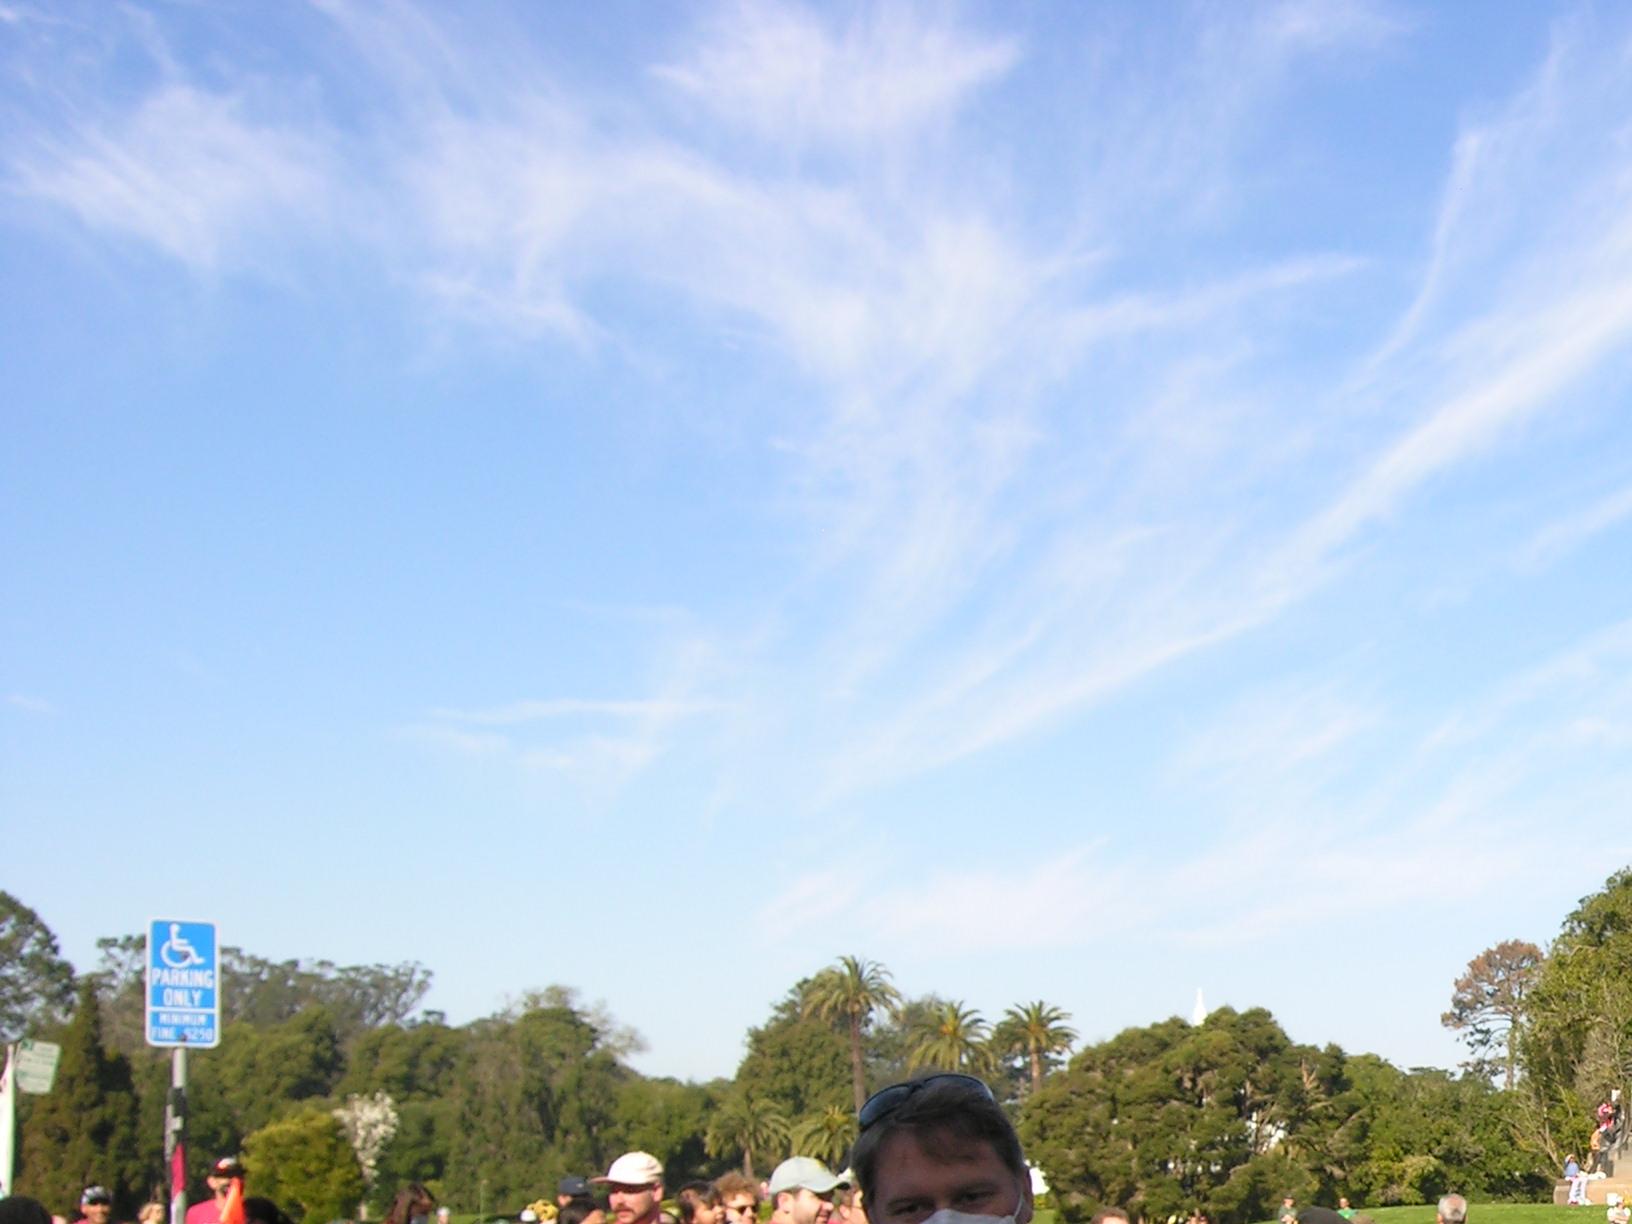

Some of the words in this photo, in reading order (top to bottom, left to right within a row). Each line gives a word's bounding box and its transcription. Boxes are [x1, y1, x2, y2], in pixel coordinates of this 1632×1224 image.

[151, 968, 213, 989] PARKING
[163, 988, 203, 1007] ONLY
[159, 1012, 207, 1025] MINIMUM
